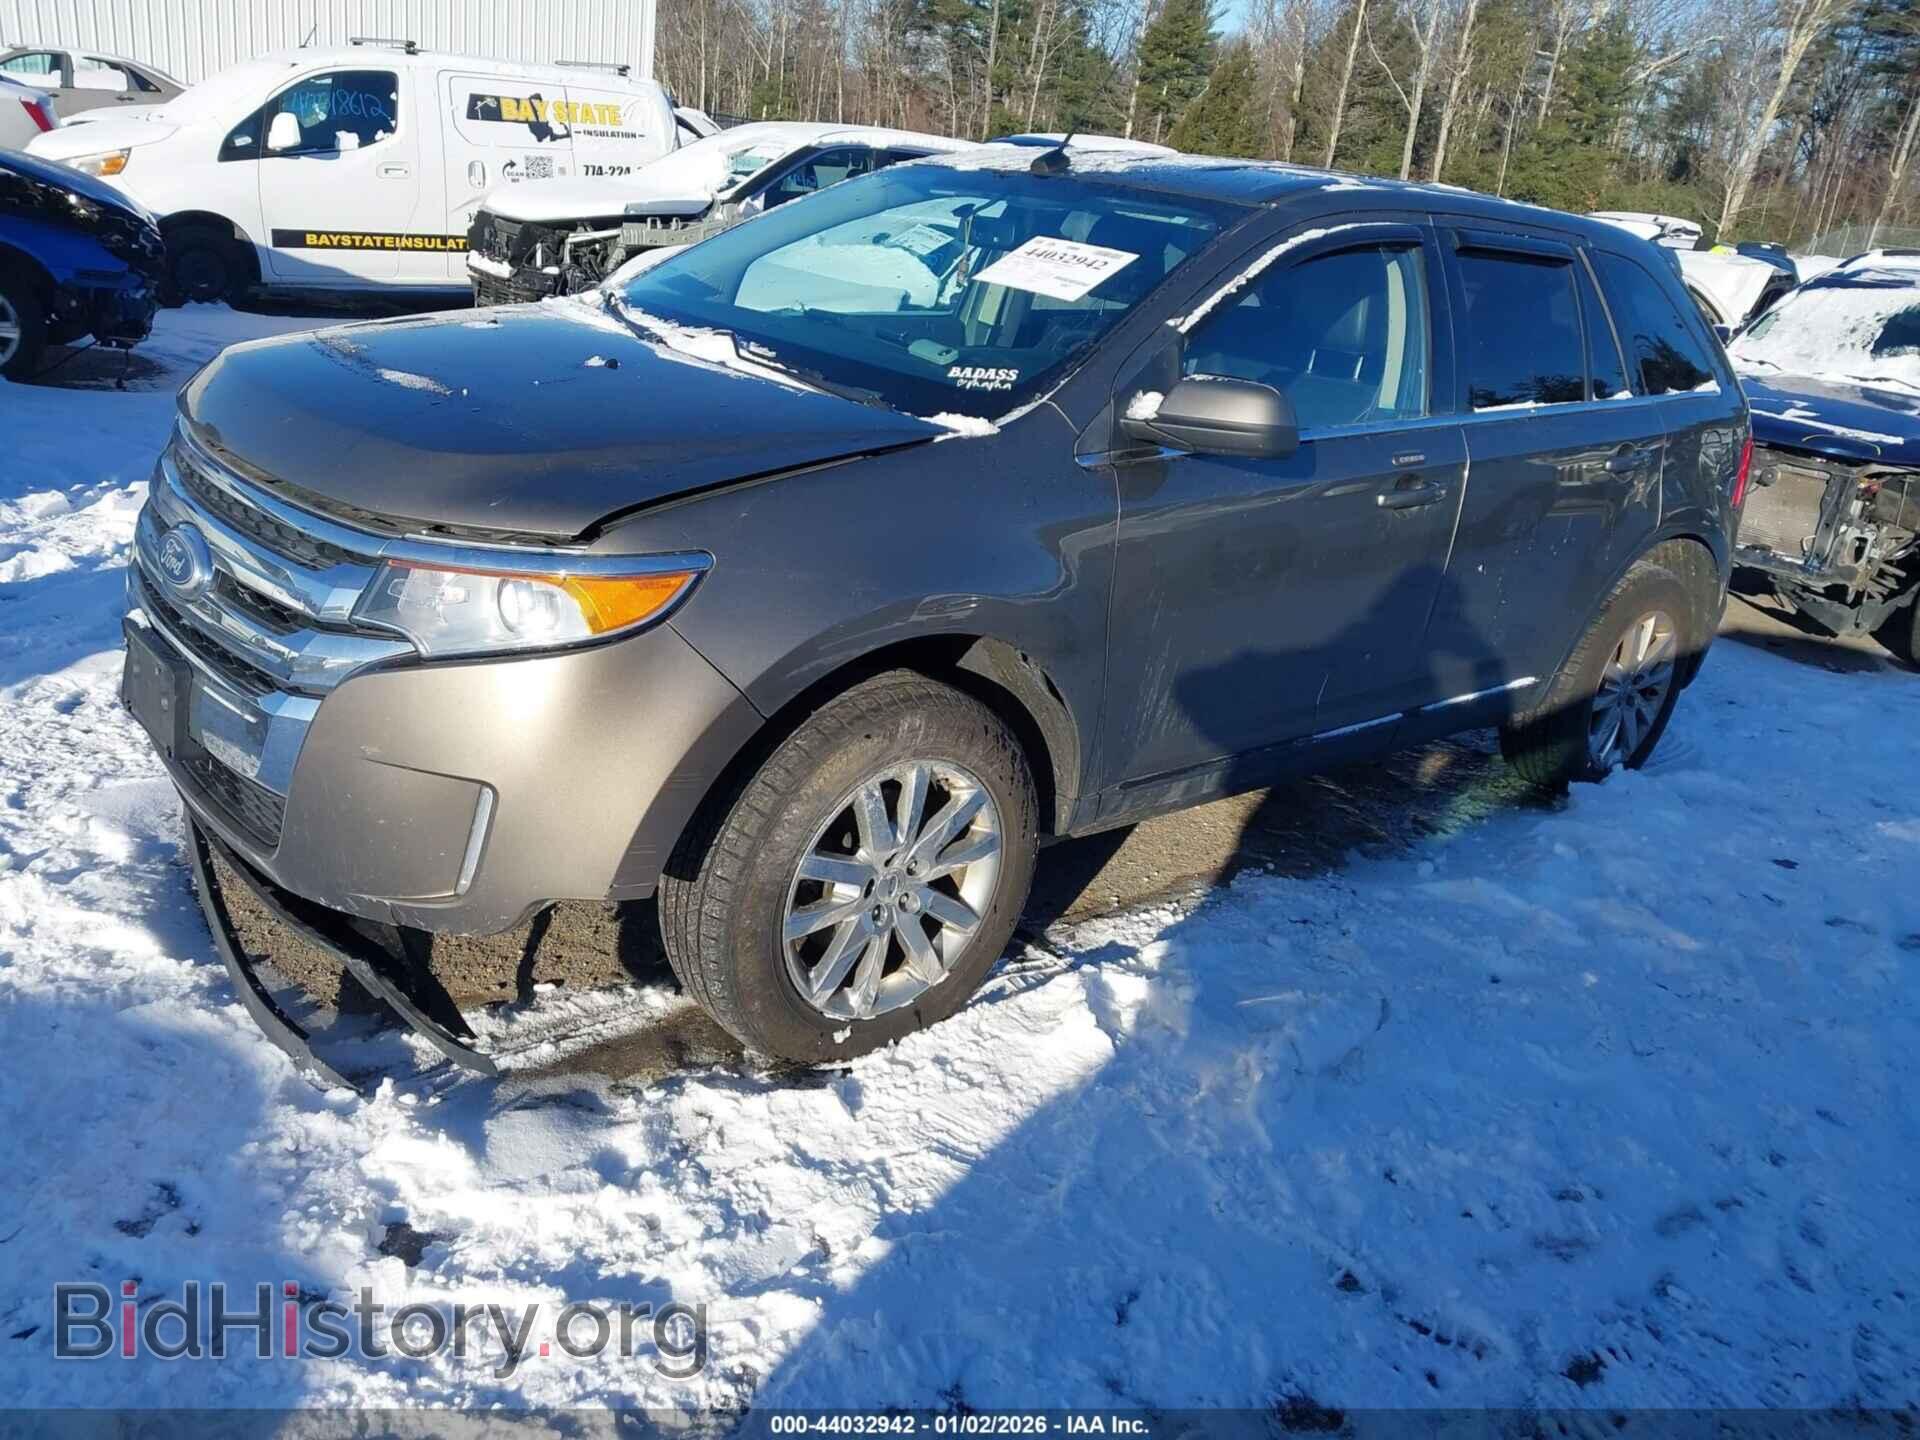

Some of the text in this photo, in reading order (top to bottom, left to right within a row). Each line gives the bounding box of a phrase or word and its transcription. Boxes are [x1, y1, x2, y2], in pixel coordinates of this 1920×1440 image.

[501, 98, 624, 126] BAY STATE
[583, 129, 637, 139] INSULATION
[1024, 249, 1109, 271] 44032942
[947, 366, 1019, 381] BADASS
[161, 538, 186, 576] Ford
